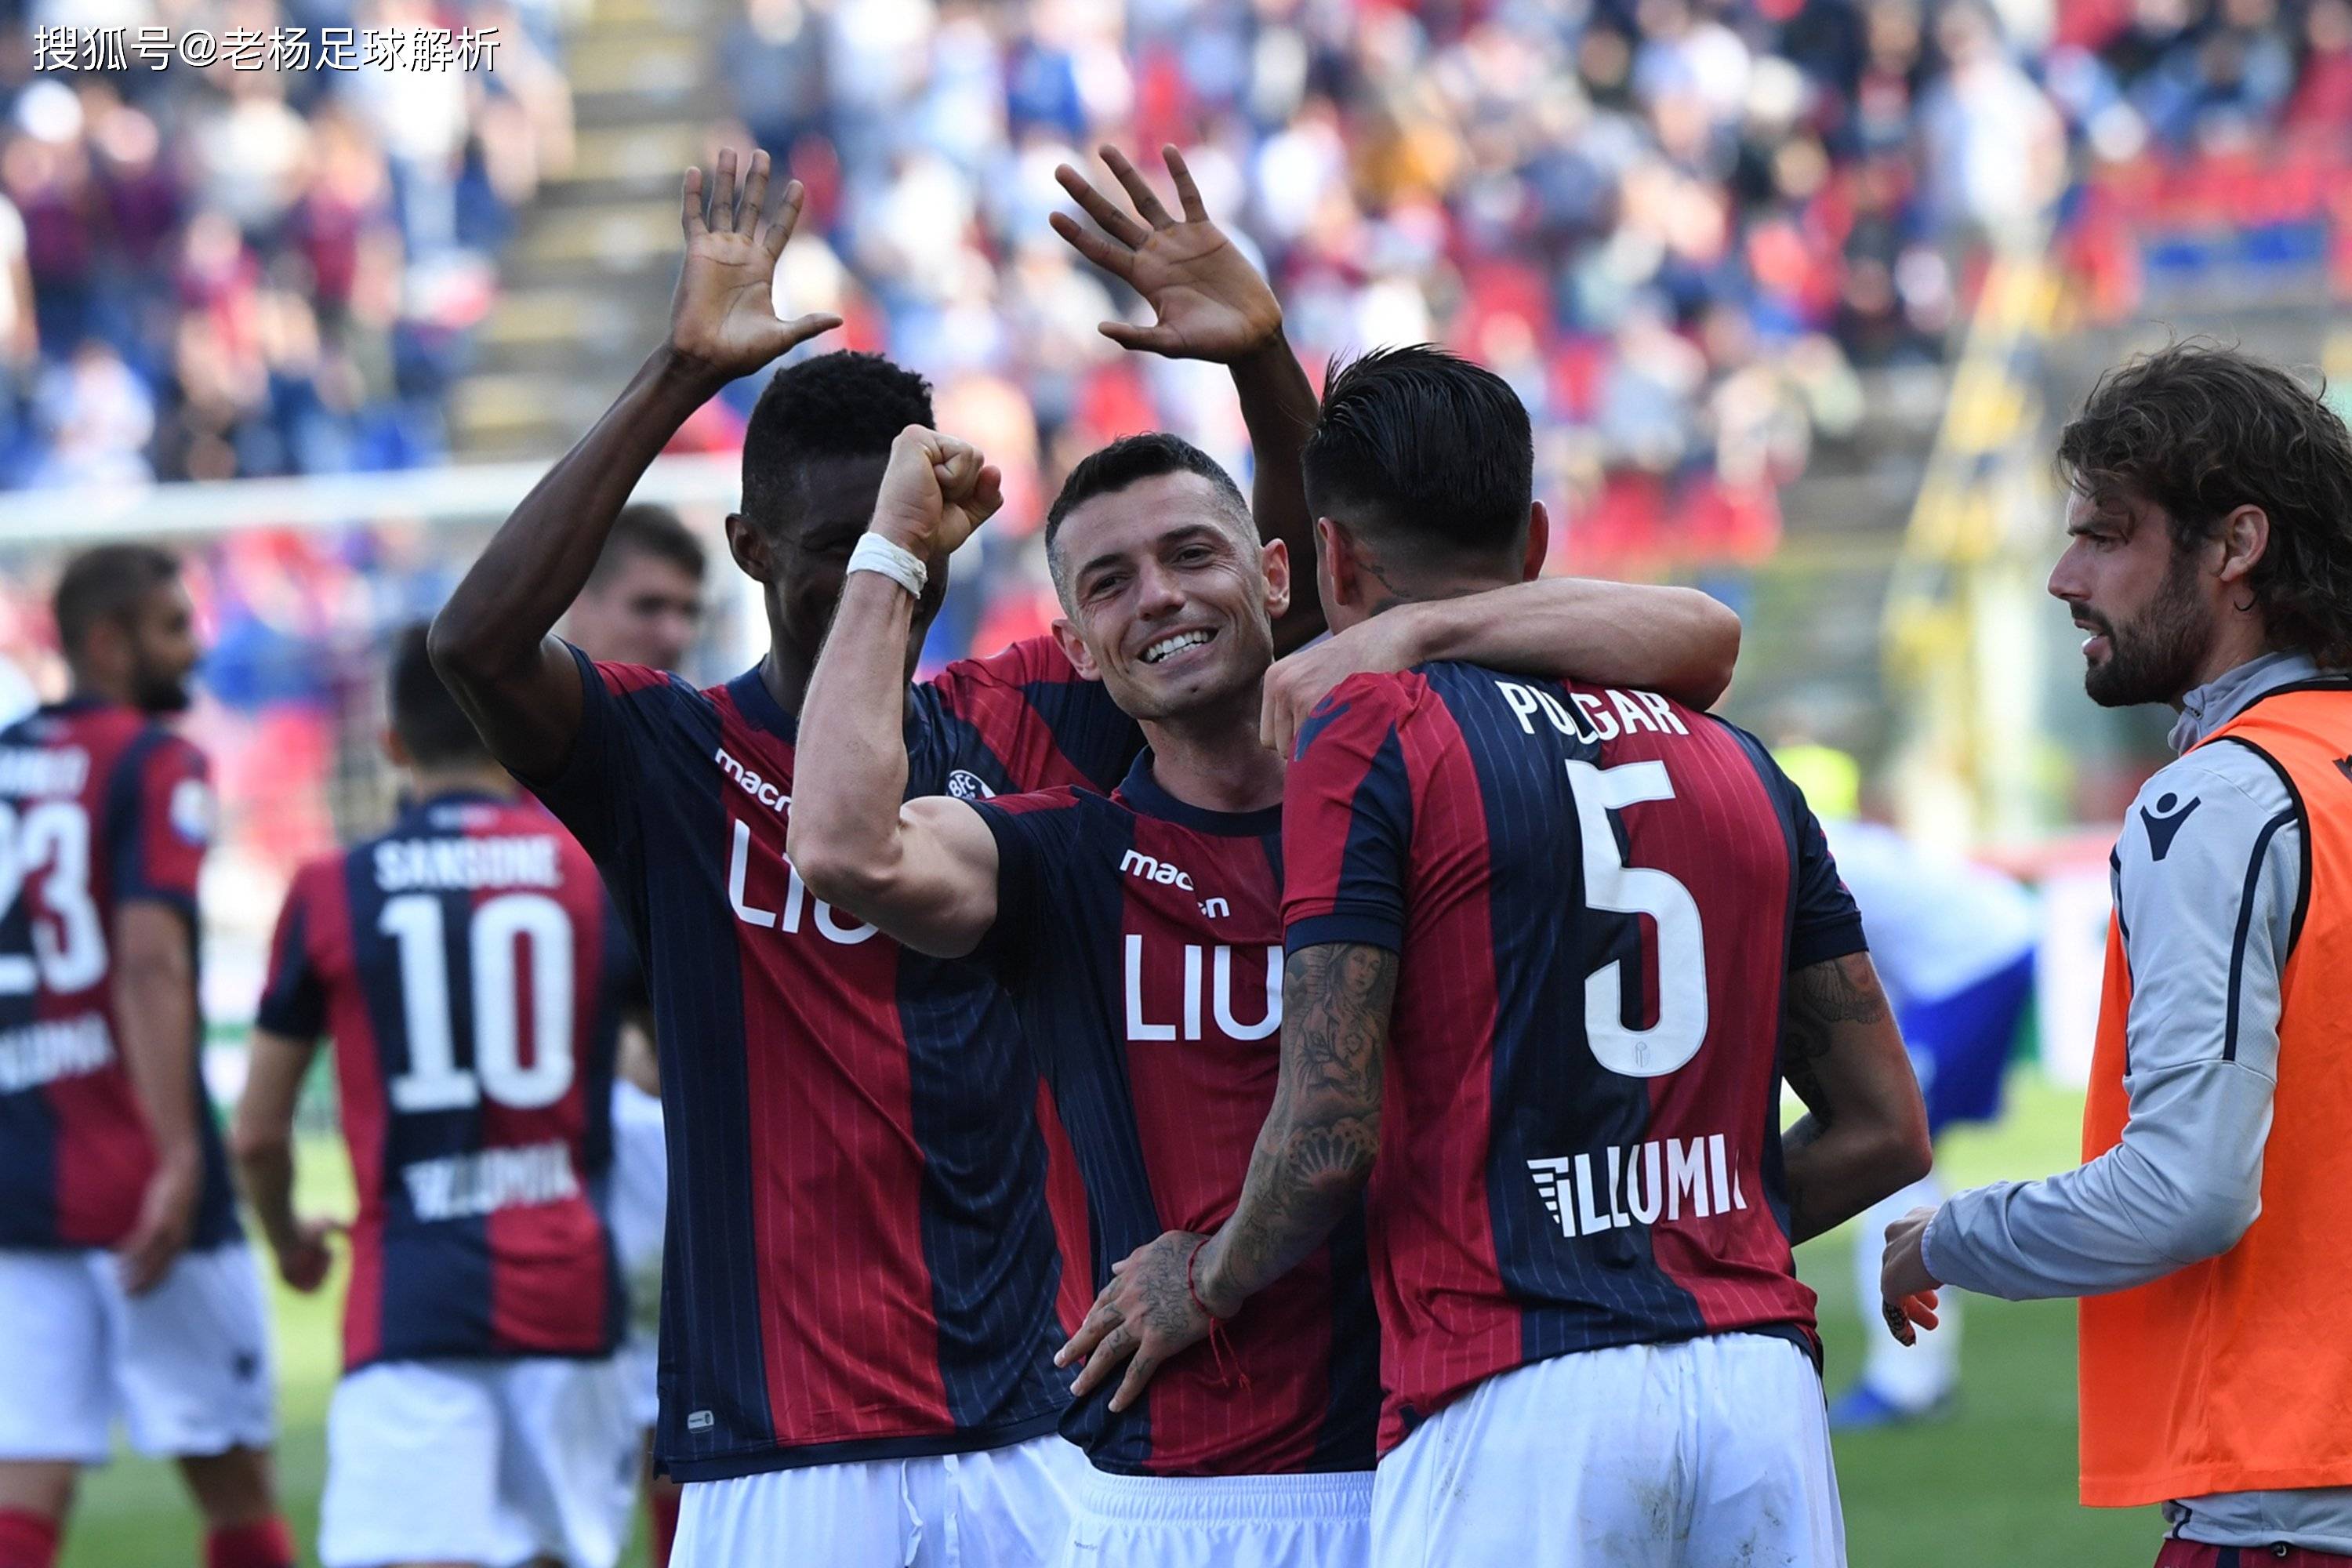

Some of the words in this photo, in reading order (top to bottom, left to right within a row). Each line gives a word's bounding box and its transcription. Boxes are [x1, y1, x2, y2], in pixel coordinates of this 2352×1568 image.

[1120, 849, 1229, 919] macn
[1564, 758, 1709, 1078] 5
[378, 894, 575, 1112] 10
[1125, 934, 1284, 1041] LIU
